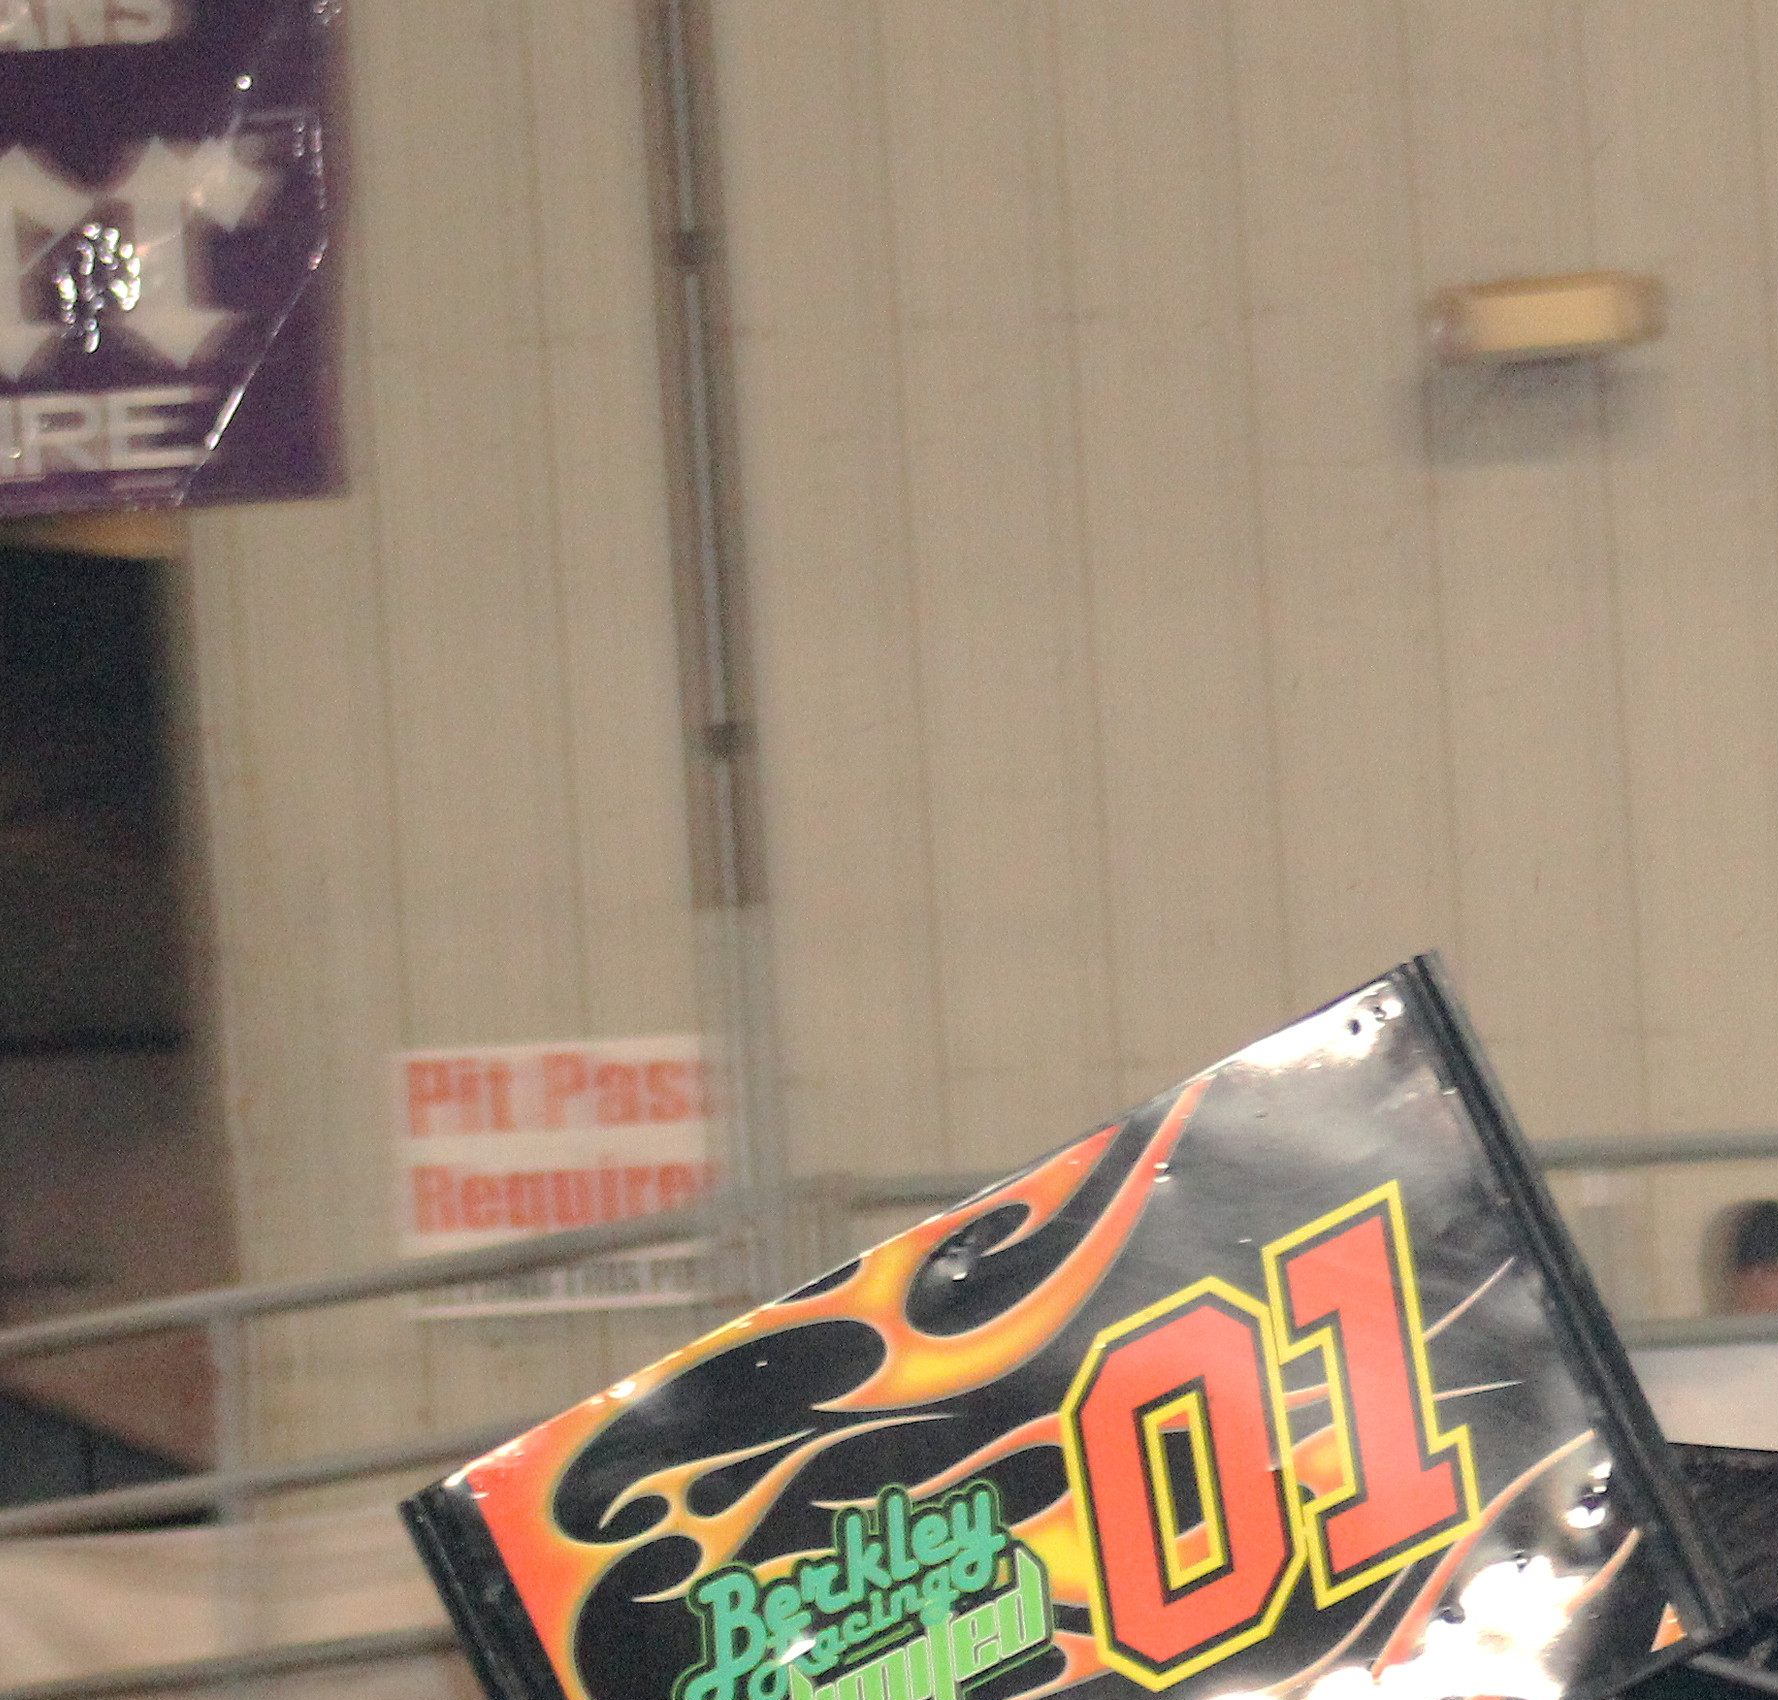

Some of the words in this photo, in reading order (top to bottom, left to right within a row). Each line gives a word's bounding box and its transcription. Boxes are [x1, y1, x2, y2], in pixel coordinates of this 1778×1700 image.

[406, 1056, 514, 1137] Pit
[412, 1158, 715, 1236] Require
[1062, 1180, 1484, 1691] 01
